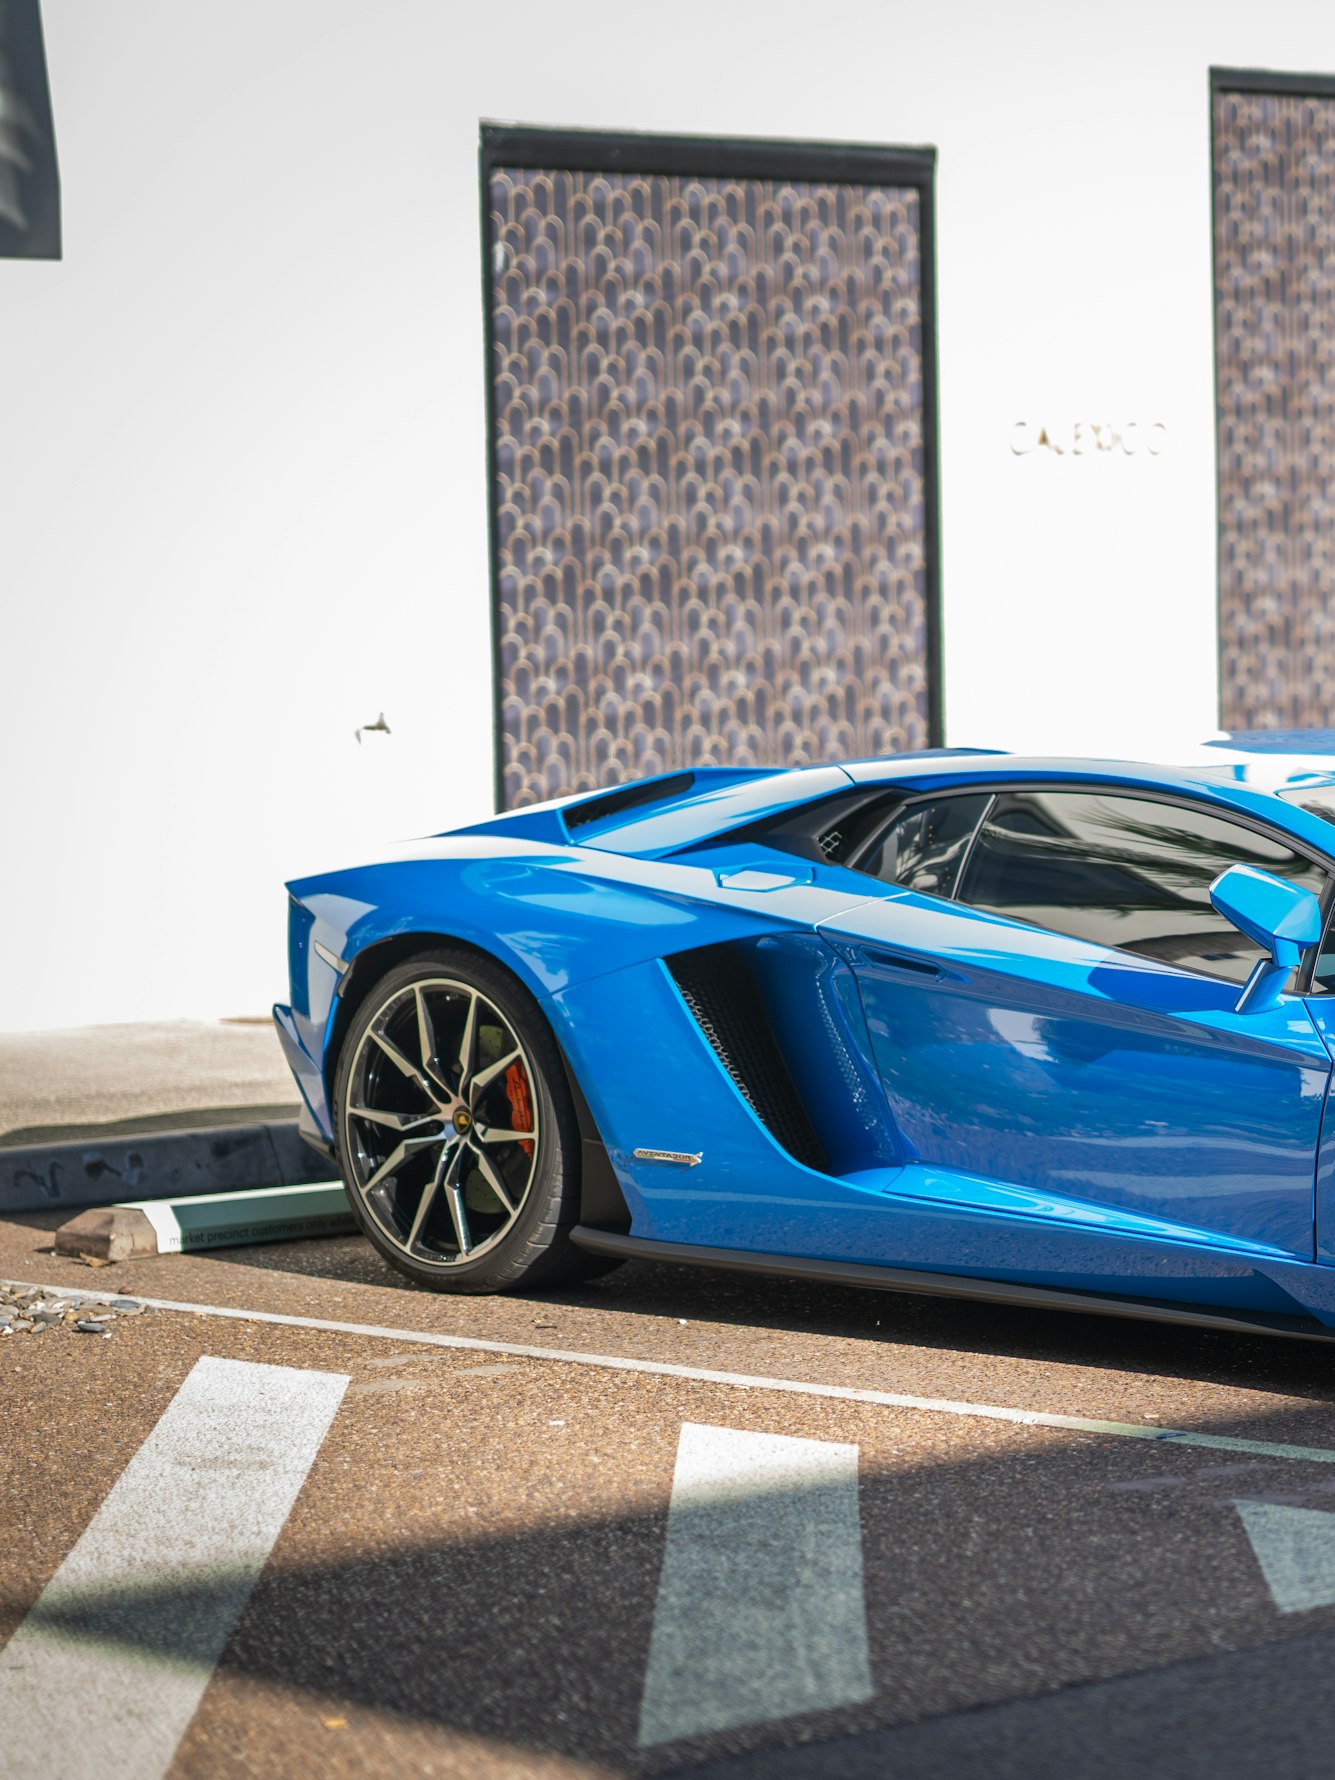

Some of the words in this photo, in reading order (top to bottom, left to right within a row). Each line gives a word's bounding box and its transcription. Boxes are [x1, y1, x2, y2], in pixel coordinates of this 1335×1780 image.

[637, 1150, 692, 1161] AVENTADOR
[207, 1228, 249, 1242] precinct
[251, 1221, 304, 1237] customers
